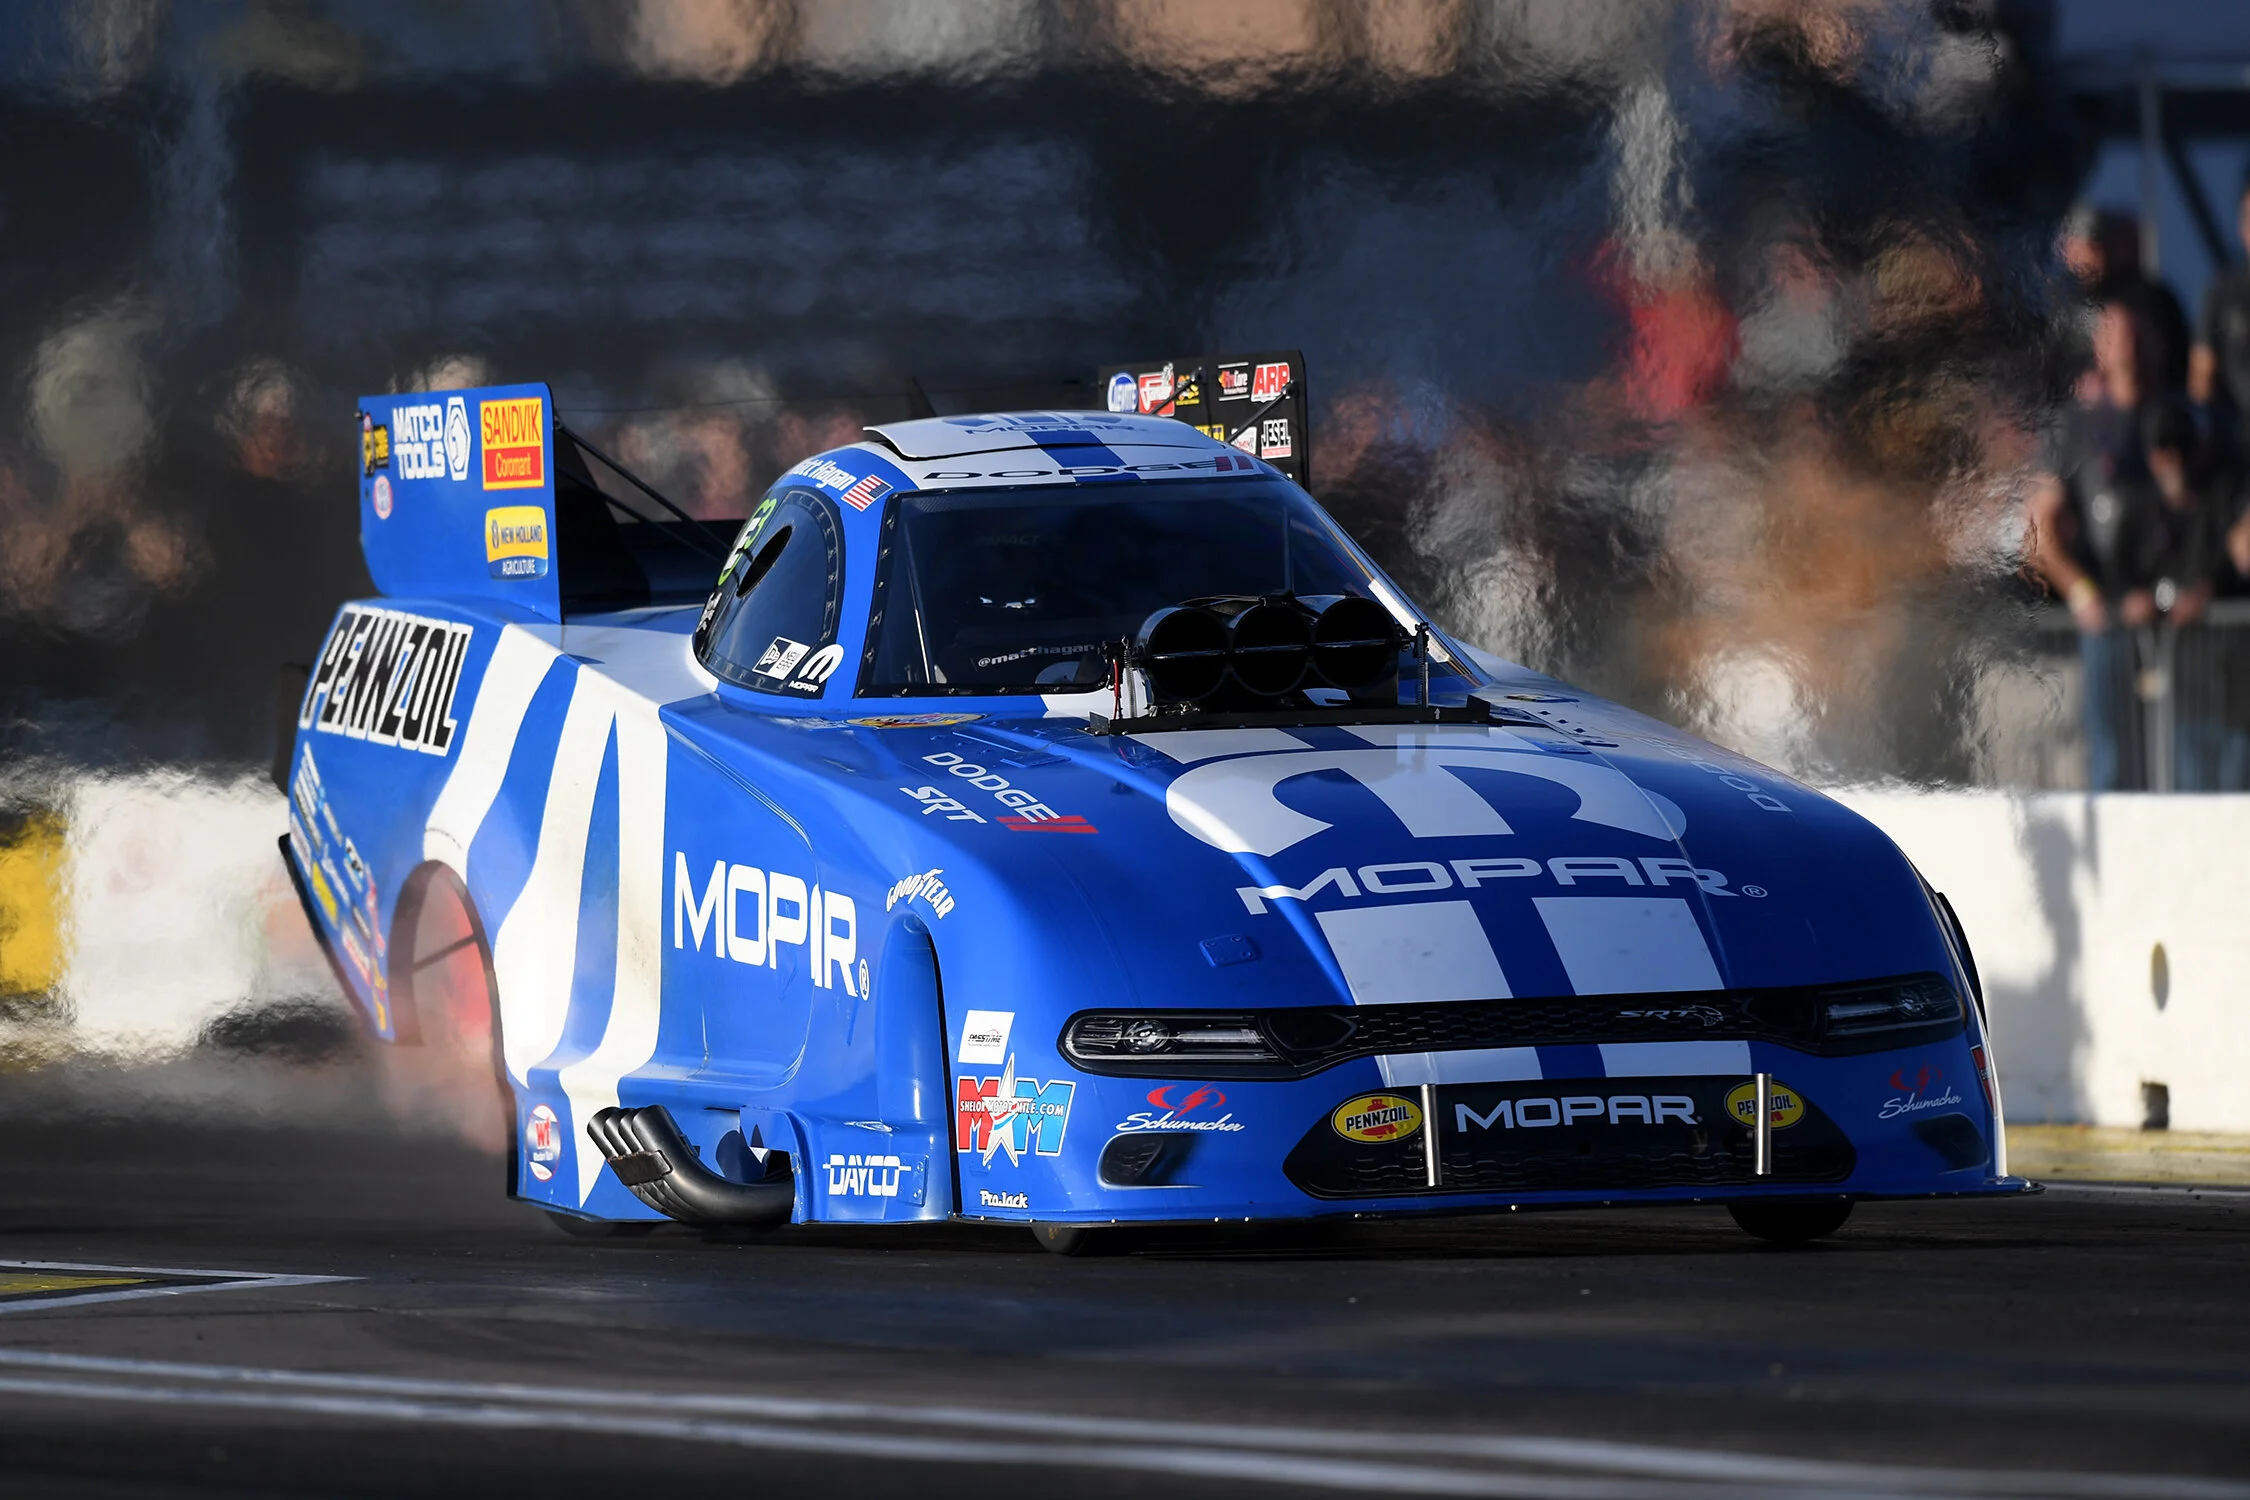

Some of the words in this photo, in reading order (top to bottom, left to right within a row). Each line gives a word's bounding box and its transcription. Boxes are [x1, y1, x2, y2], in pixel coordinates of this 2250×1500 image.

[392, 404, 443, 443] MATCO
[483, 403, 541, 445] SANDVIK
[1261, 420, 1290, 447] JESEL
[394, 441, 446, 480] TOOLS
[495, 452, 532, 478] Coromant
[811, 460, 858, 491] Hagan
[923, 459, 1217, 480] DODGE
[501, 526, 514, 544] NEW
[515, 524, 542, 544] HOLLAND
[502, 558, 536, 575] AGRICULTURE
[298, 603, 474, 757] PENNZOIL
[788, 680, 819, 693] MOPAR
[921, 752, 1061, 823] DODGE
[899, 786, 988, 824] SRT
[886, 868, 956, 920] GOODYEAR
[1236, 857, 1740, 915] MOPAR
[1616, 1010, 1698, 1020] SRT
[1345, 1105, 1411, 1132] PENNZOIL
[1455, 1095, 1698, 1133] MOPAR
[1878, 1085, 1962, 1119] Schumacher
[1115, 1111, 1246, 1132] Schumacher
[828, 1154, 901, 1197] DAYCO
